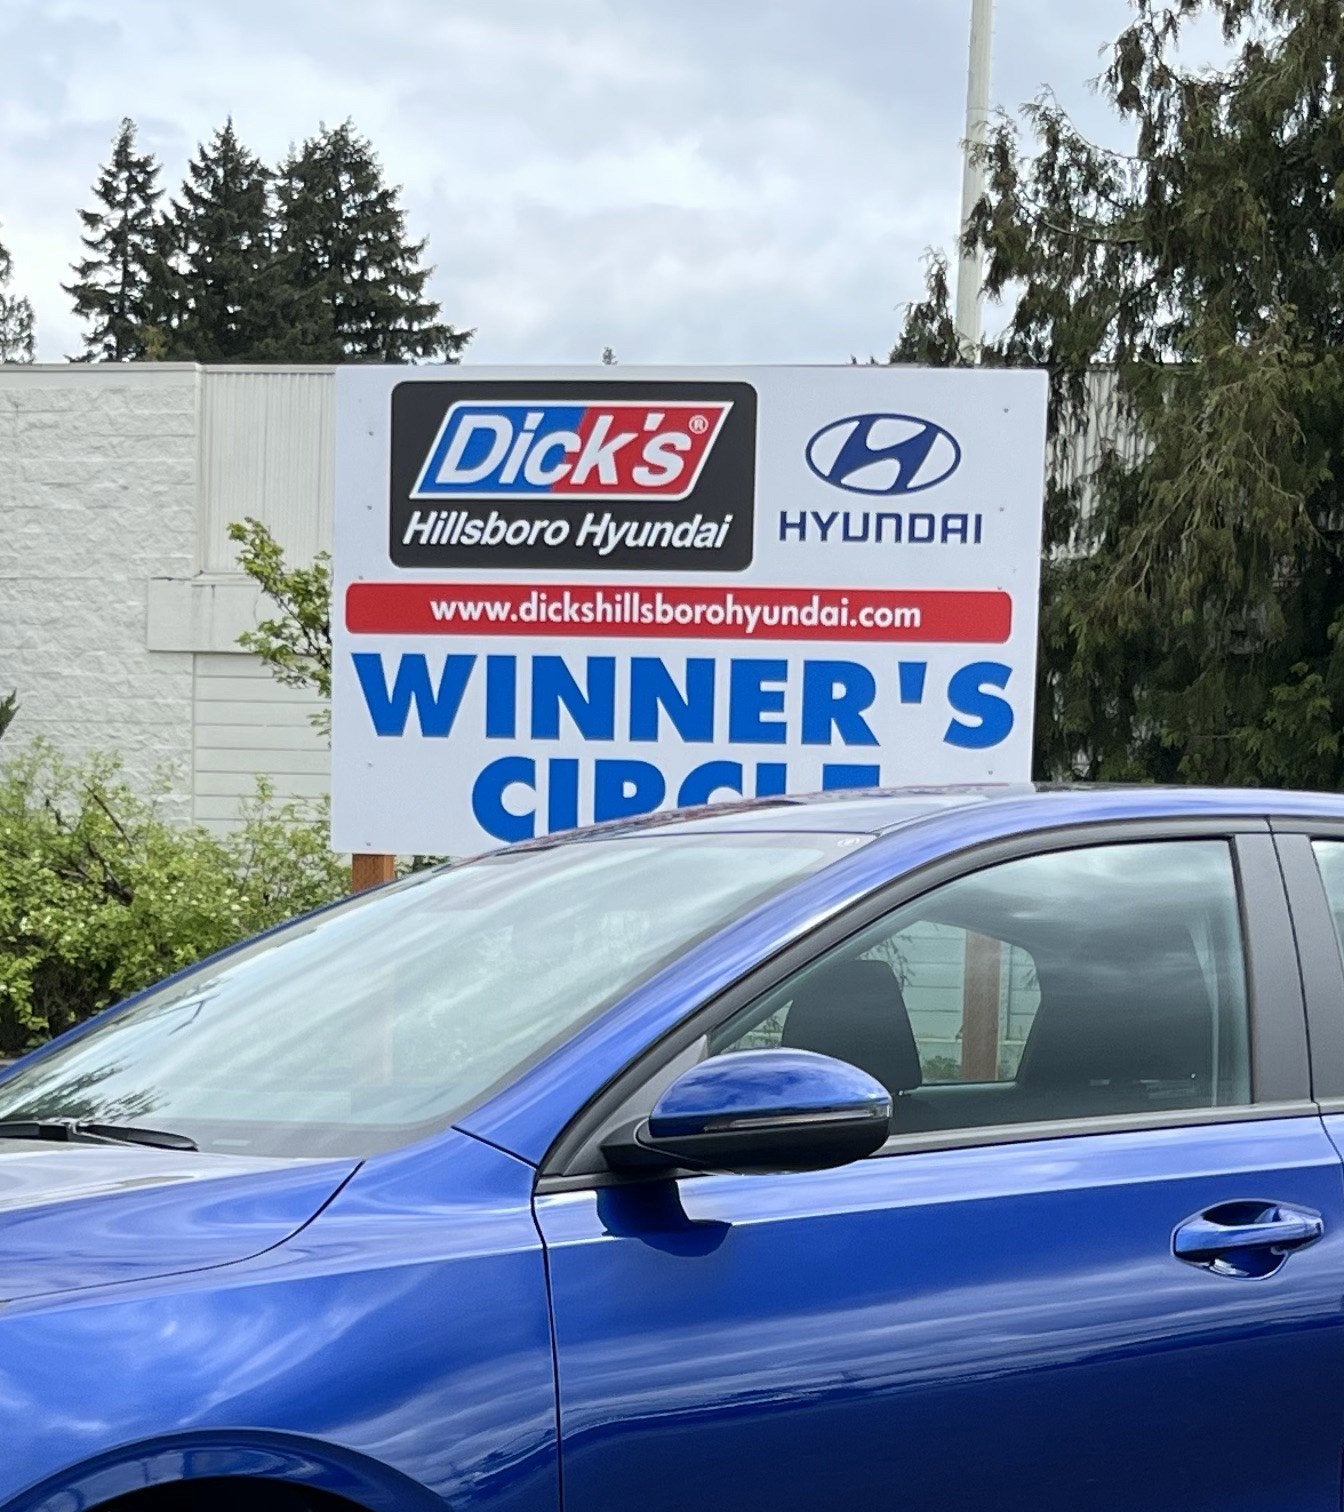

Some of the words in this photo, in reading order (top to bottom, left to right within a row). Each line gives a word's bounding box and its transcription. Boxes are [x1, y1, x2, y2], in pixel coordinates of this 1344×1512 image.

[402, 510, 571, 549] Hillsboro
[575, 513, 734, 556] Hyundai
[779, 510, 983, 545] HYUNDAI
[429, 591, 922, 634] www.dickshillsborohyundai.com
[351, 652, 1015, 749] WINNER'S
